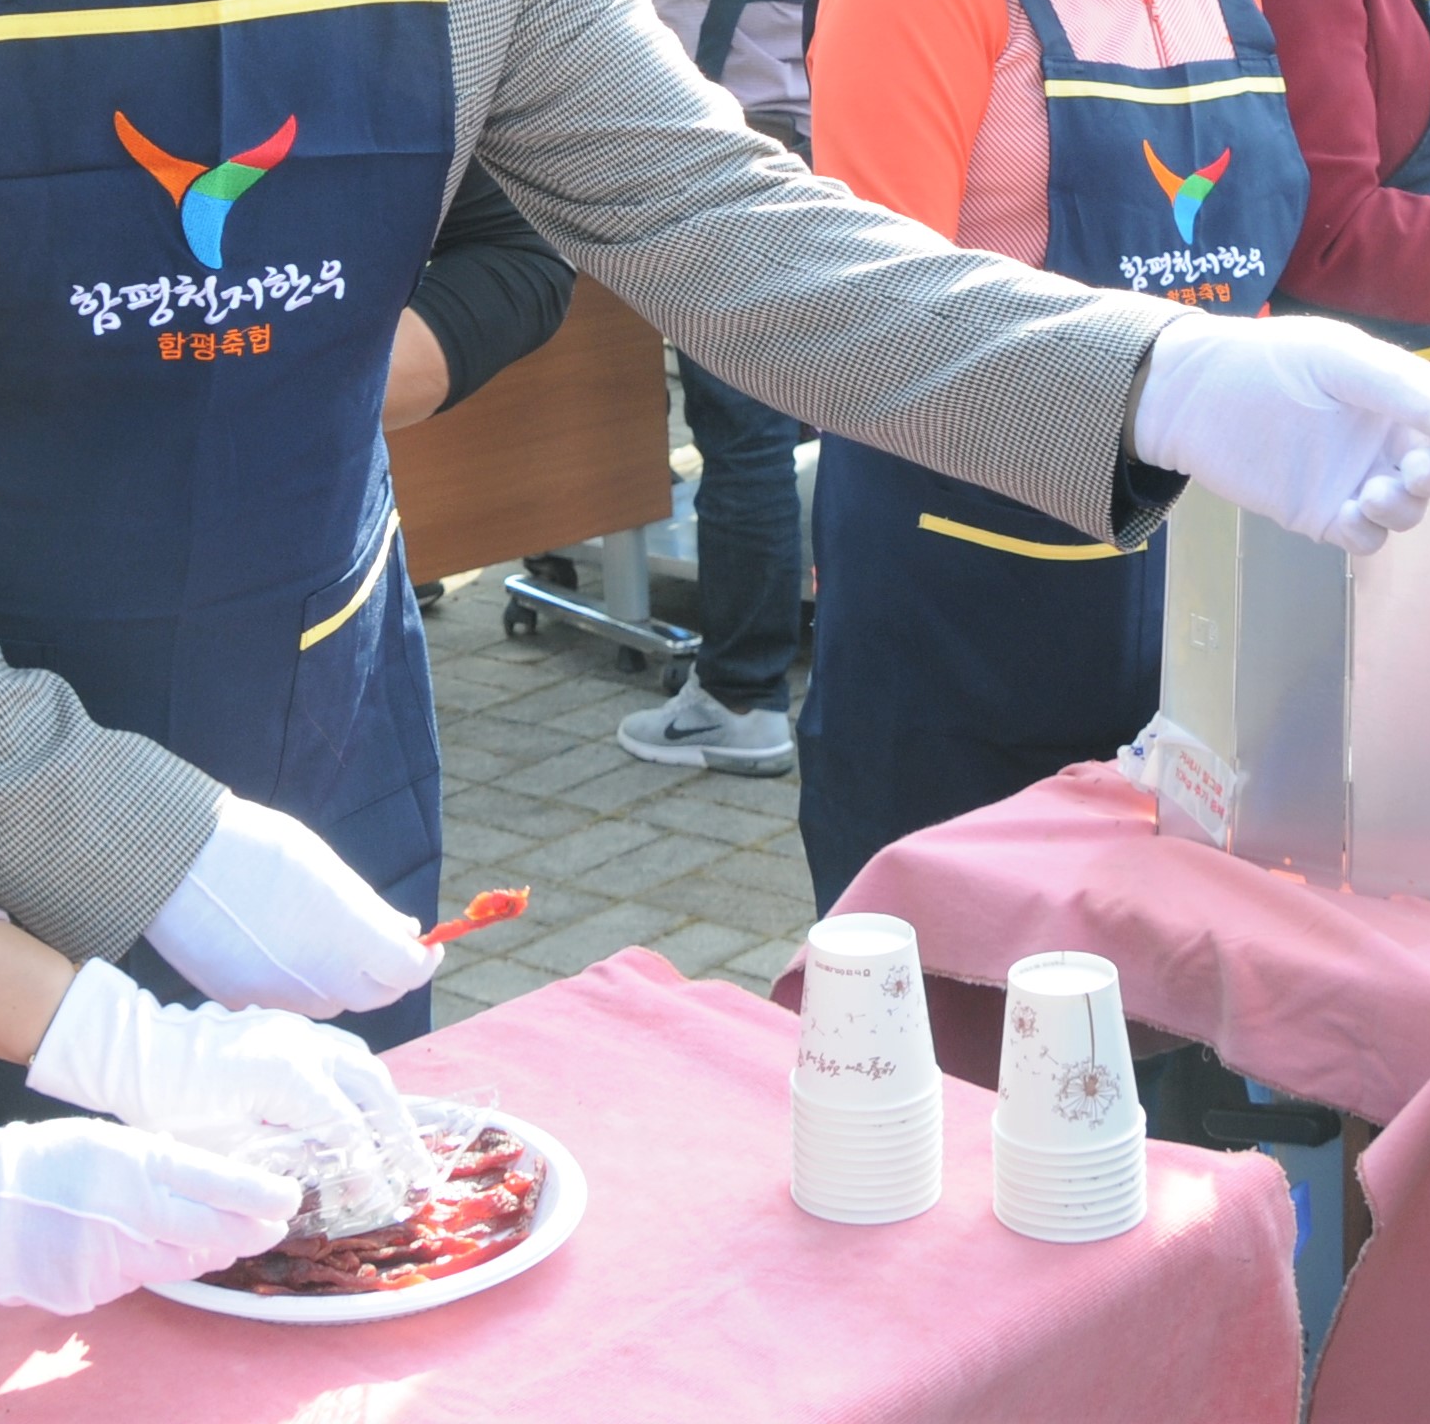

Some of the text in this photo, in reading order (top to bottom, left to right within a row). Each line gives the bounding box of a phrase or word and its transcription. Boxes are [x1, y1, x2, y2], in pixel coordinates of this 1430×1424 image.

[1119, 245, 1266, 292] 함평천지한우
[70, 260, 346, 336] 함평천지한우
[157, 323, 272, 362] 함평축협
